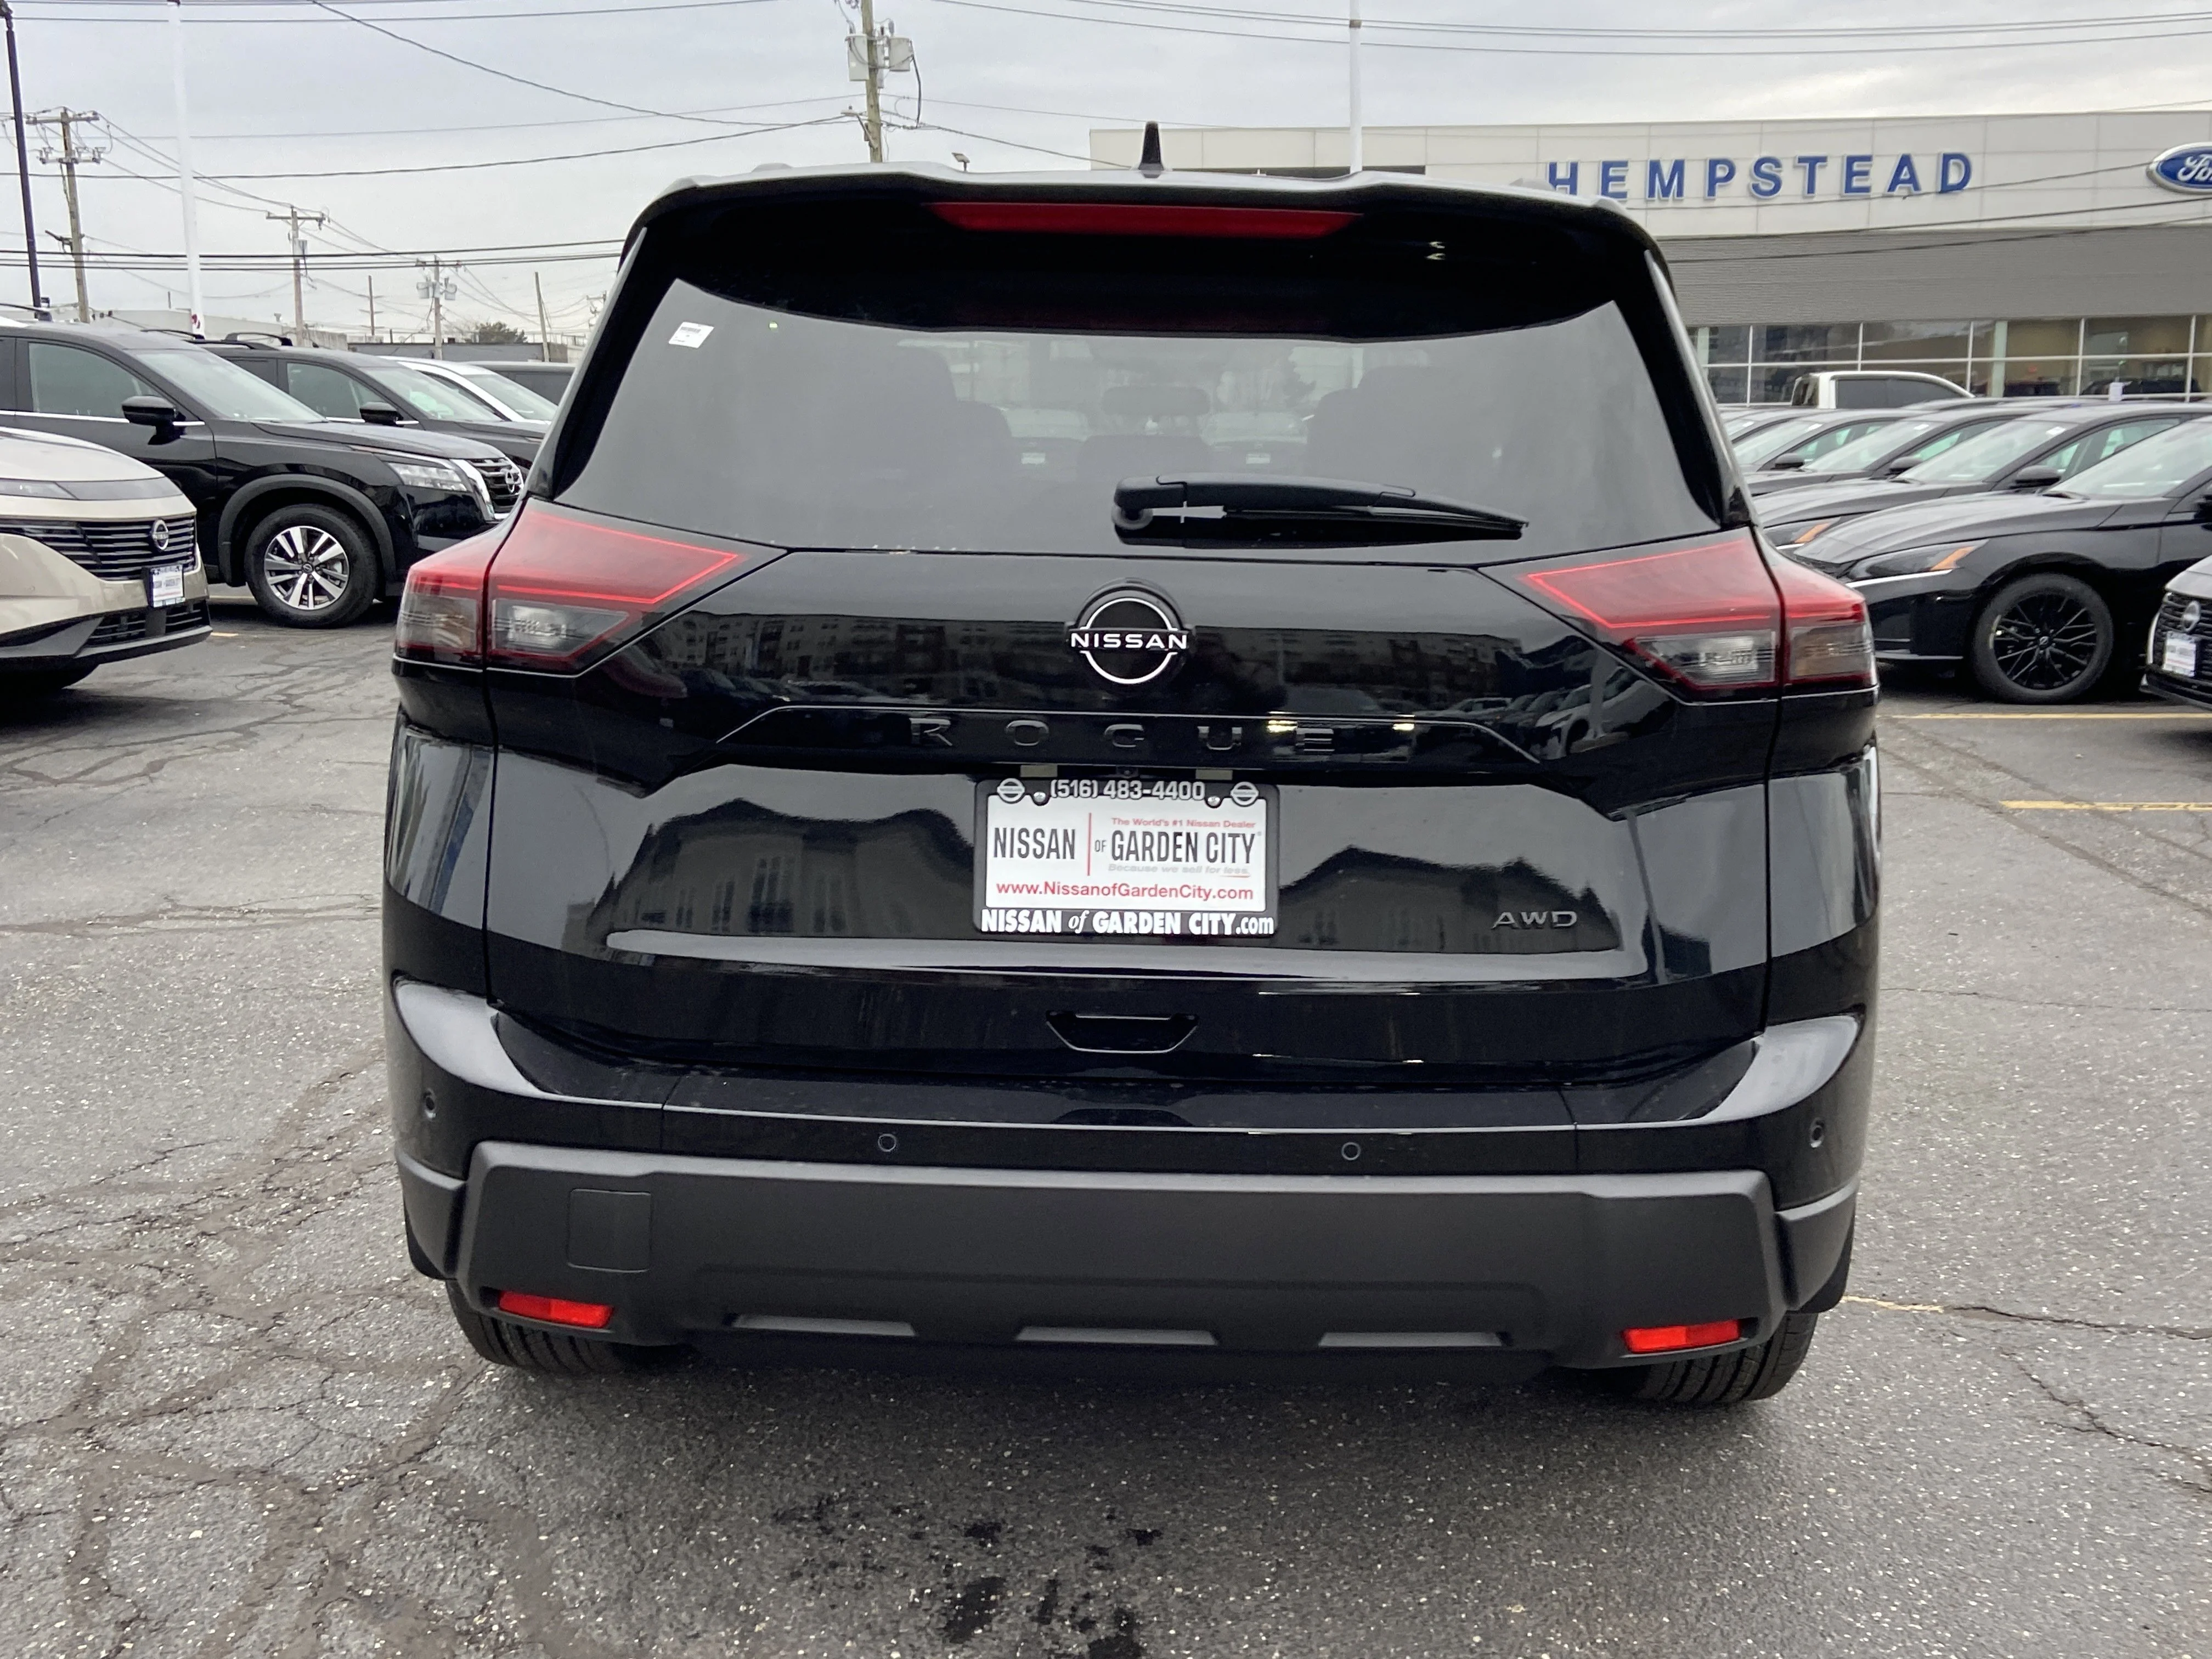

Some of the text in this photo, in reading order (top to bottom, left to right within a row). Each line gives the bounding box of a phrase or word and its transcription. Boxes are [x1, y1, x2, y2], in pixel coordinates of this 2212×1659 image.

[1548, 151, 1972, 199] HEMPSTEAD
[1070, 633, 1188, 650] NISSAN
[909, 717, 1335, 752] ROGUE
[1051, 779, 1206, 801] (516) 483-4400
[1111, 817, 1129, 826] The
[1132, 818, 1170, 827] World's
[1187, 820, 1220, 828] Nissan
[1223, 820, 1256, 828] Dealer
[994, 827, 1255, 864] NISSAN OF GARDEN CITY
[1108, 864, 1158, 873] Because
[1182, 865, 1203, 873] sell
[1205, 865, 1220, 874] for
[996, 882, 1254, 901] www.NissanofGardenCity.com
[981, 909, 1274, 935] NISSAN of GARDEN CITY.com
[1491, 911, 1577, 929] AWD
